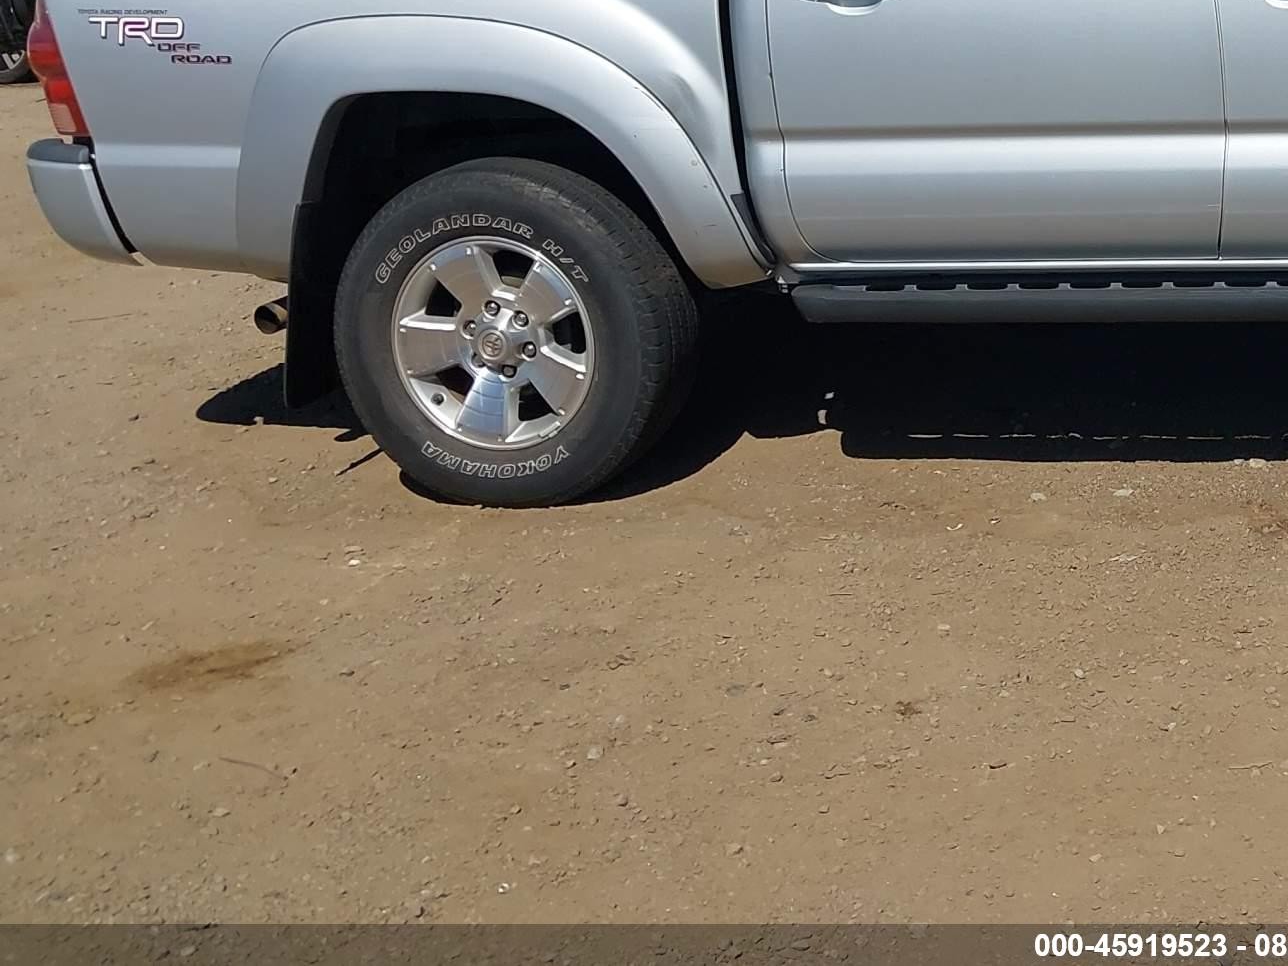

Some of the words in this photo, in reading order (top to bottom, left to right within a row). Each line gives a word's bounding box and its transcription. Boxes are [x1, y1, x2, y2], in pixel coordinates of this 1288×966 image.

[88, 17, 184, 46] TRD
[157, 43, 201, 52] OFF
[171, 54, 232, 64] ROAD
[375, 214, 534, 284] GEOLANDAR
[542, 239, 589, 283] H/T
[421, 440, 572, 479] YOKOHAMA
